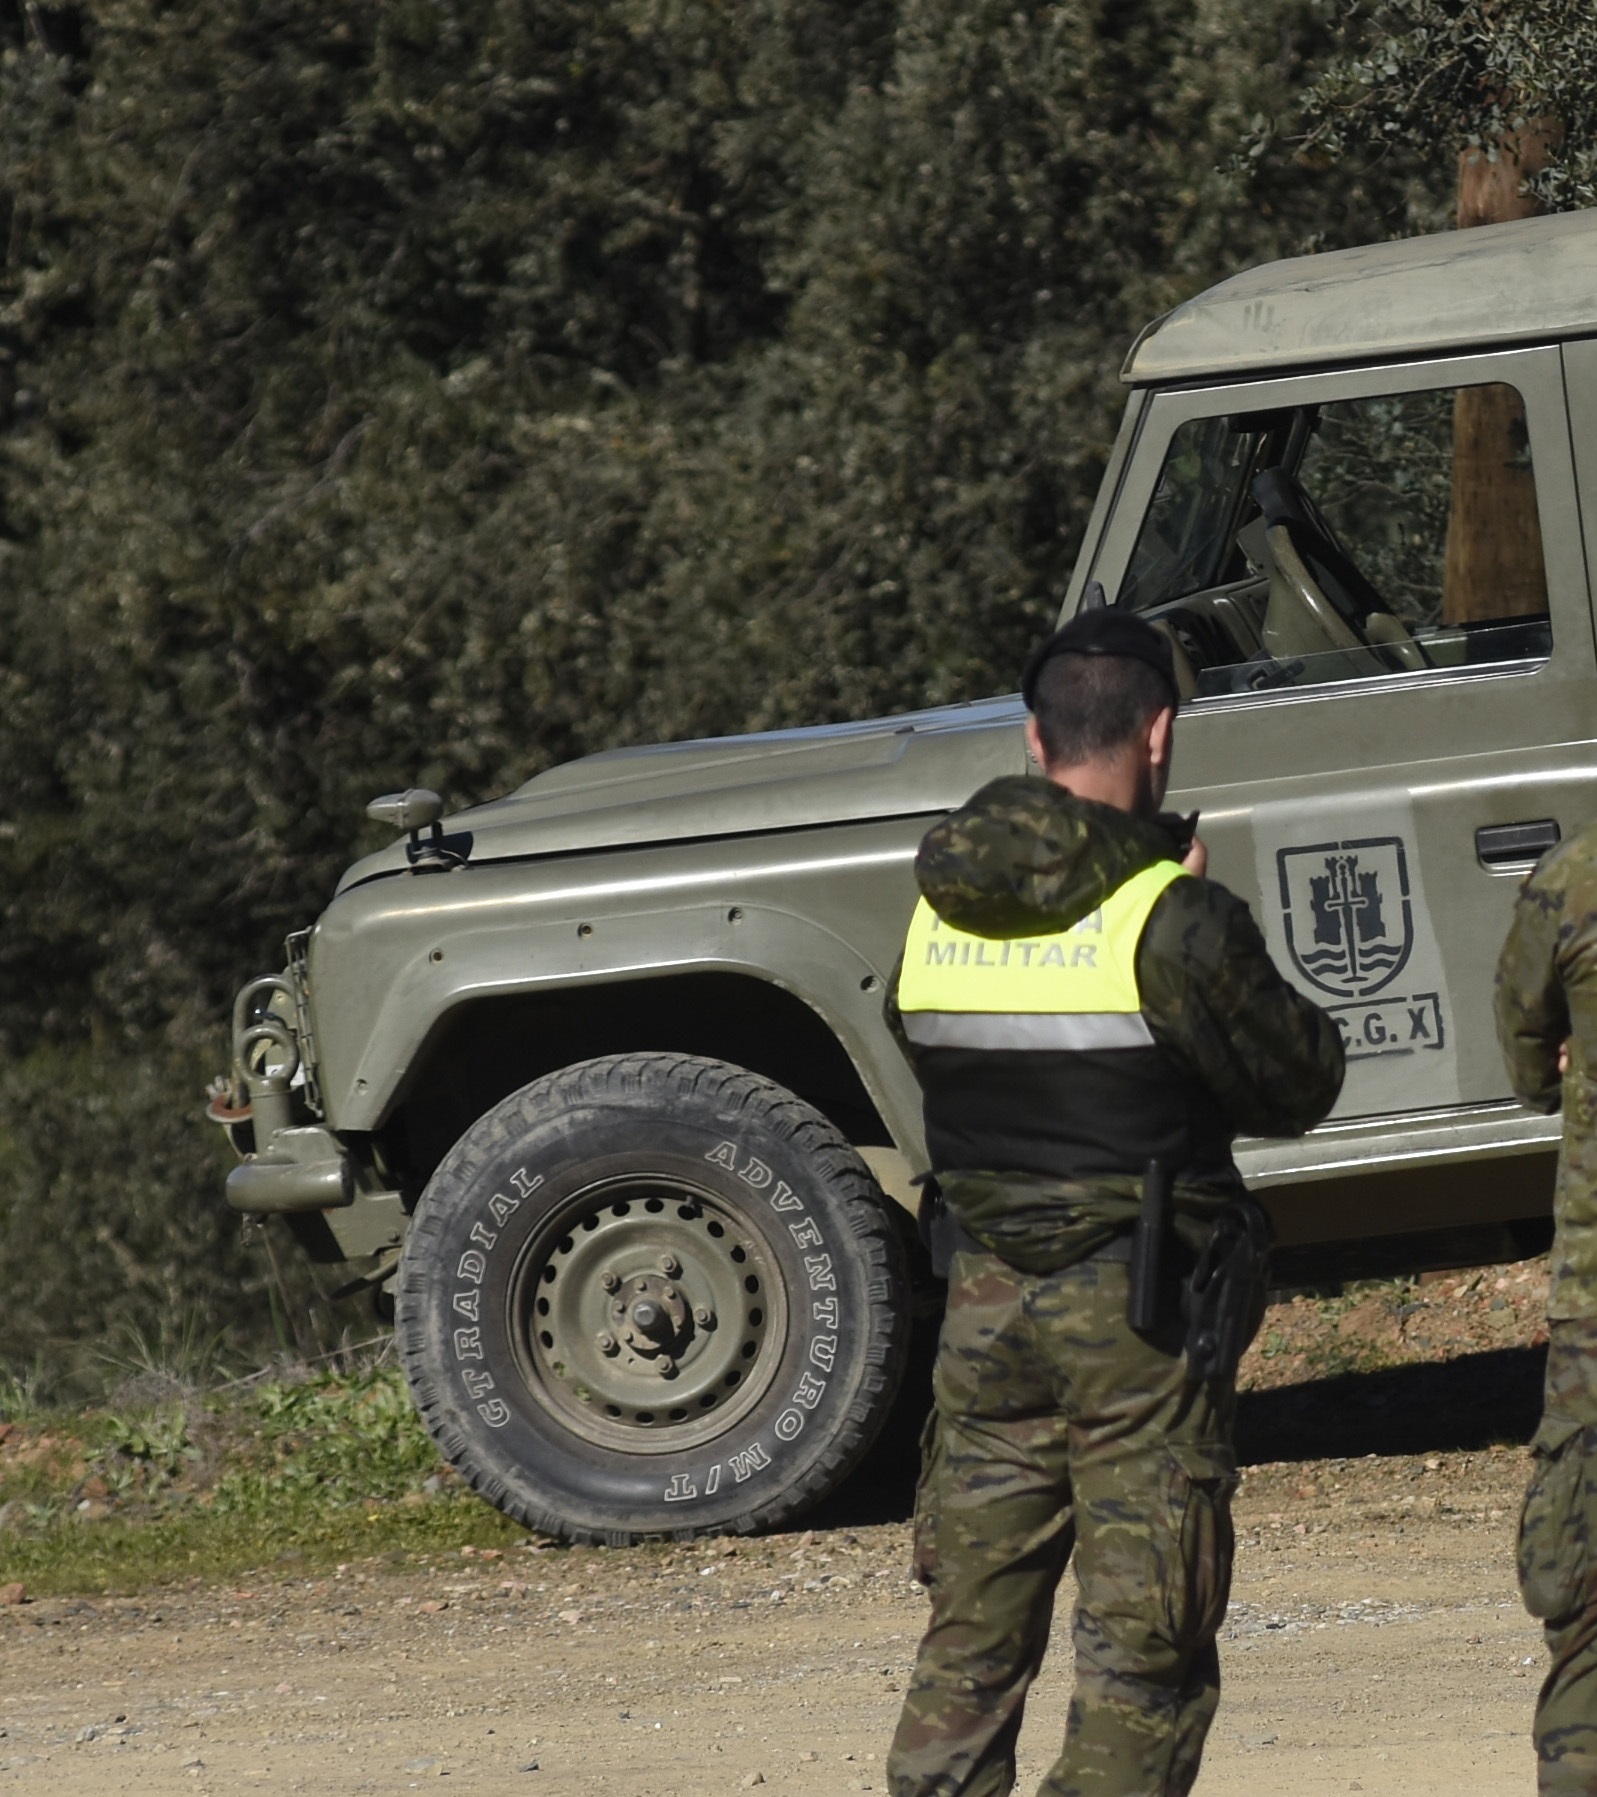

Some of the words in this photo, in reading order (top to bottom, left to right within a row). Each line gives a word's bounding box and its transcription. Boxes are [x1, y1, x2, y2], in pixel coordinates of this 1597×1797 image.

[925, 941, 1098, 969] MILITAR
[705, 1141, 839, 1442] ADVENTURO
[663, 1442, 773, 1502] M/T
